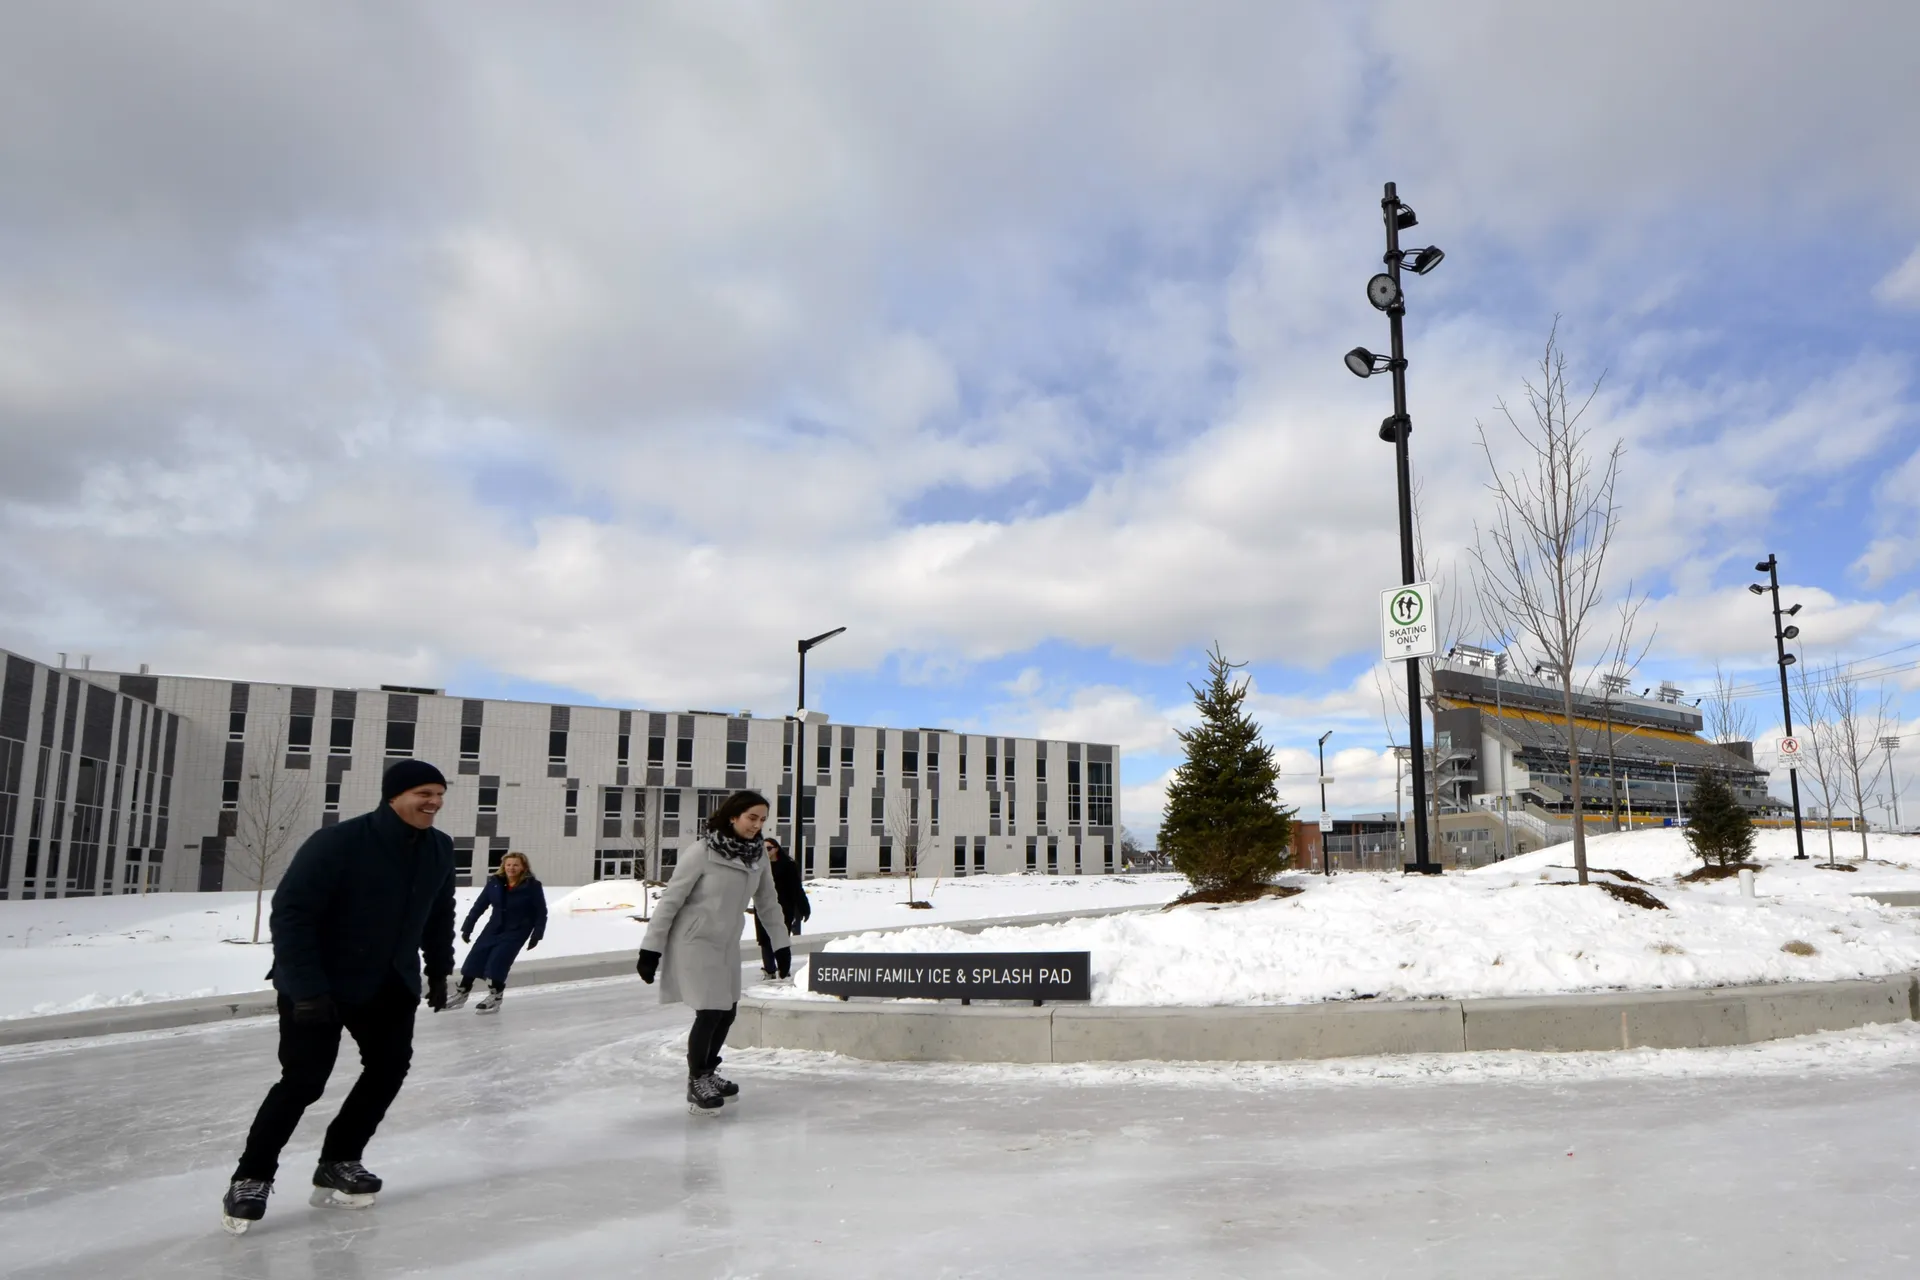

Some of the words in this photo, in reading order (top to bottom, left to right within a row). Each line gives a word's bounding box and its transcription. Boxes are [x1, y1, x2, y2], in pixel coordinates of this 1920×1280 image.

[1389, 625, 1427, 638] SKATING
[1396, 634, 1420, 645] ONLY
[817, 967, 871, 983] SERAFINI
[875, 968, 924, 983] FAMILY
[928, 968, 951, 983] ICE
[956, 968, 967, 984] &
[972, 968, 1032, 984] SPLASH
[1039, 968, 1072, 984] PAD
